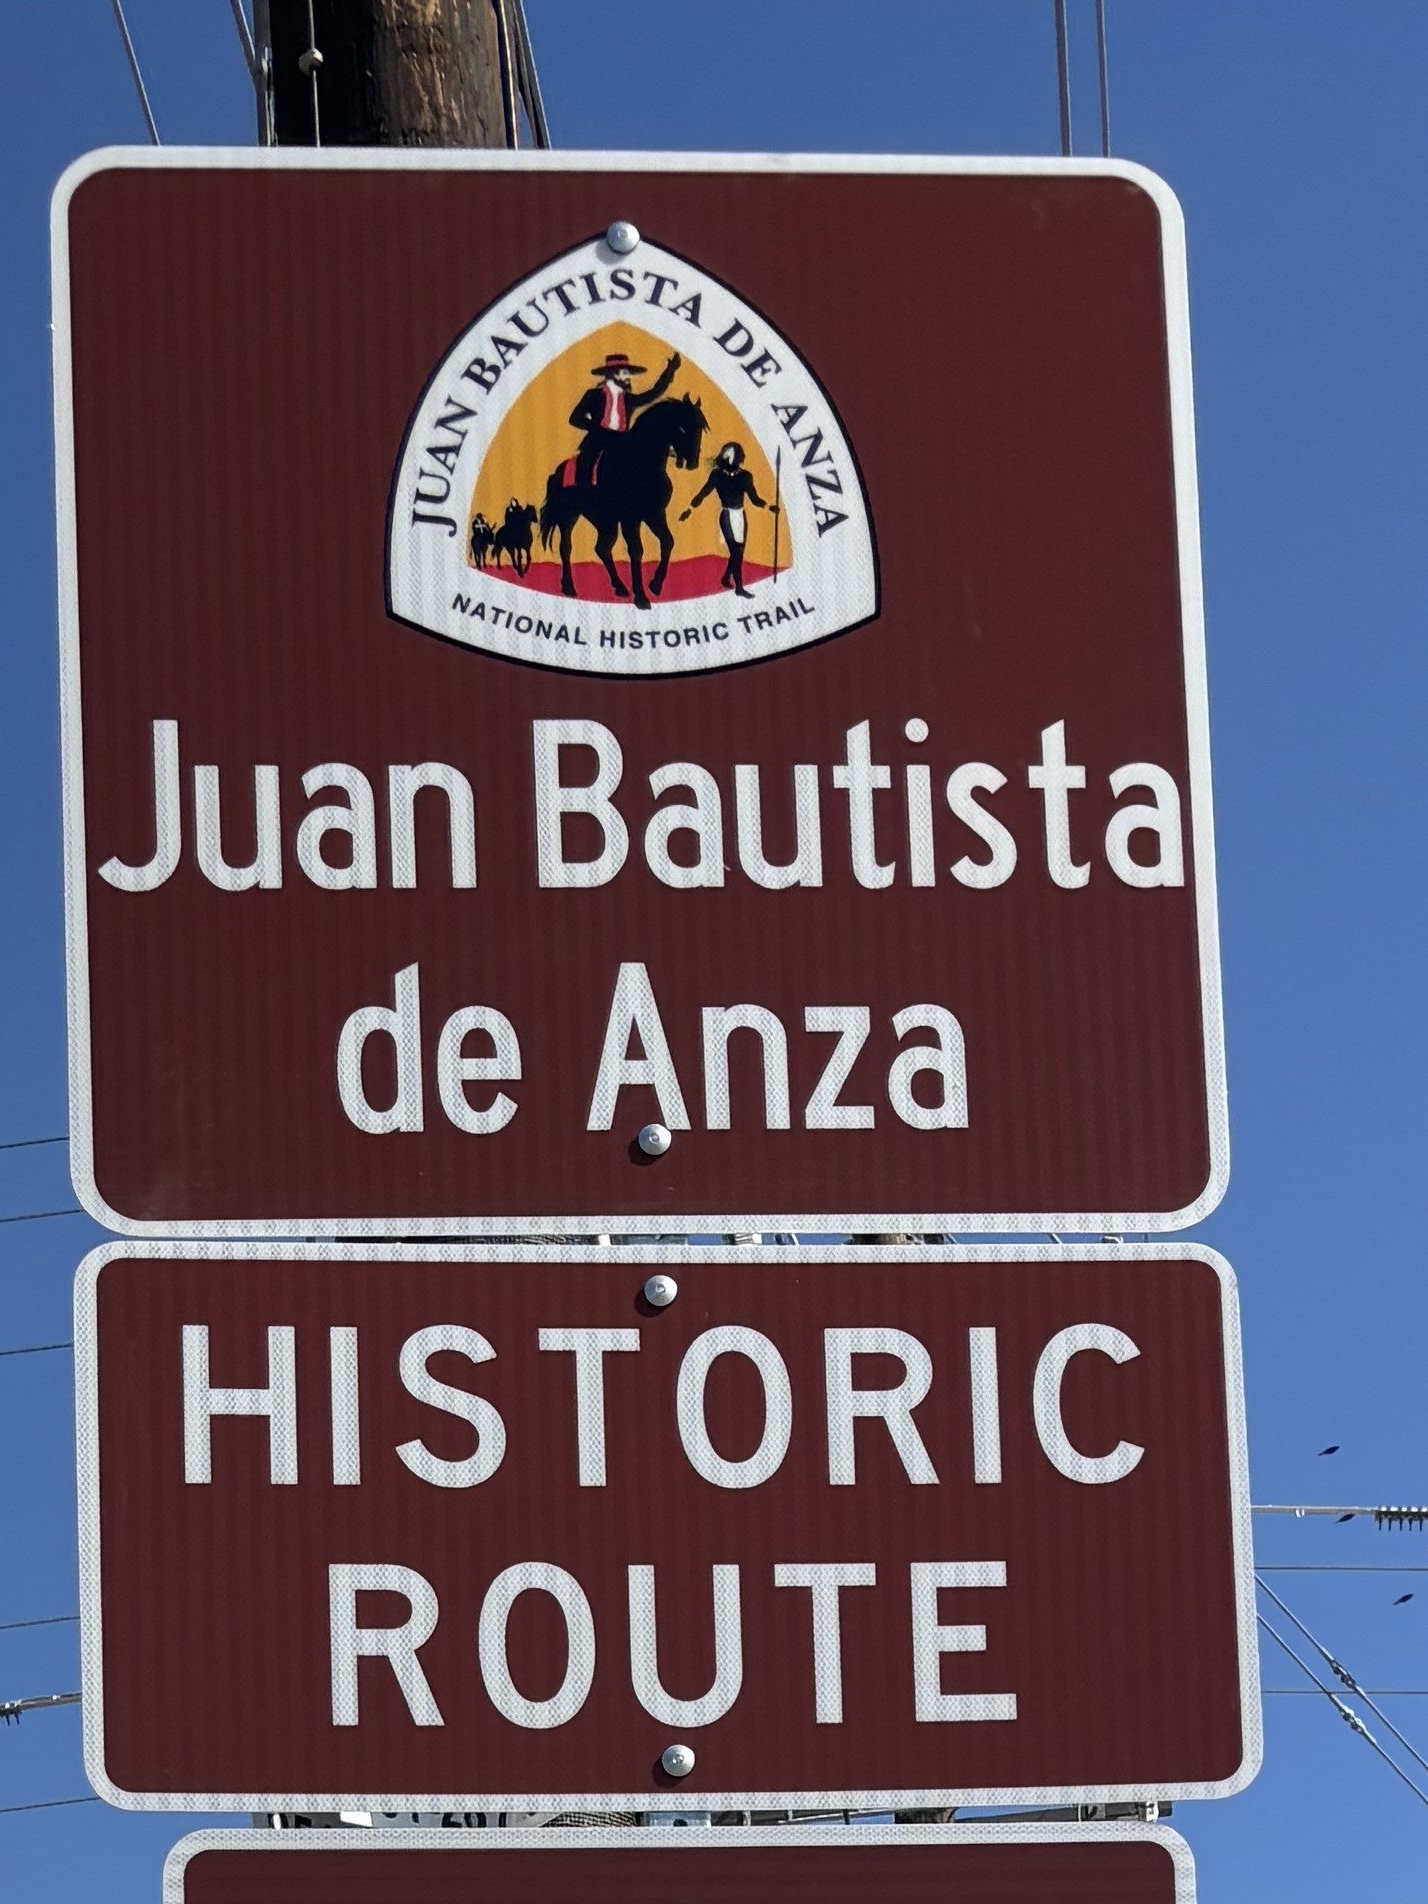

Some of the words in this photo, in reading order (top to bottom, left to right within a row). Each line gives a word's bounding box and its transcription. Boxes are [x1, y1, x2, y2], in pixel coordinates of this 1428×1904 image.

[411, 399, 478, 538] JUAN
[460, 268, 703, 396] BAUTISTA
[713, 317, 783, 389] DE
[771, 399, 850, 538] ANZA
[452, 592, 588, 646] NATIONAL
[600, 621, 730, 649] HISTORIC
[737, 597, 816, 634] TRAIL
[97, 718, 476, 894] Juan
[532, 716, 1187, 892] Bautista
[336, 961, 523, 1137] de
[587, 961, 970, 1134] Anza
[179, 1321, 1146, 1490] HISTORIC
[327, 1560, 1018, 1729] ROUTE
